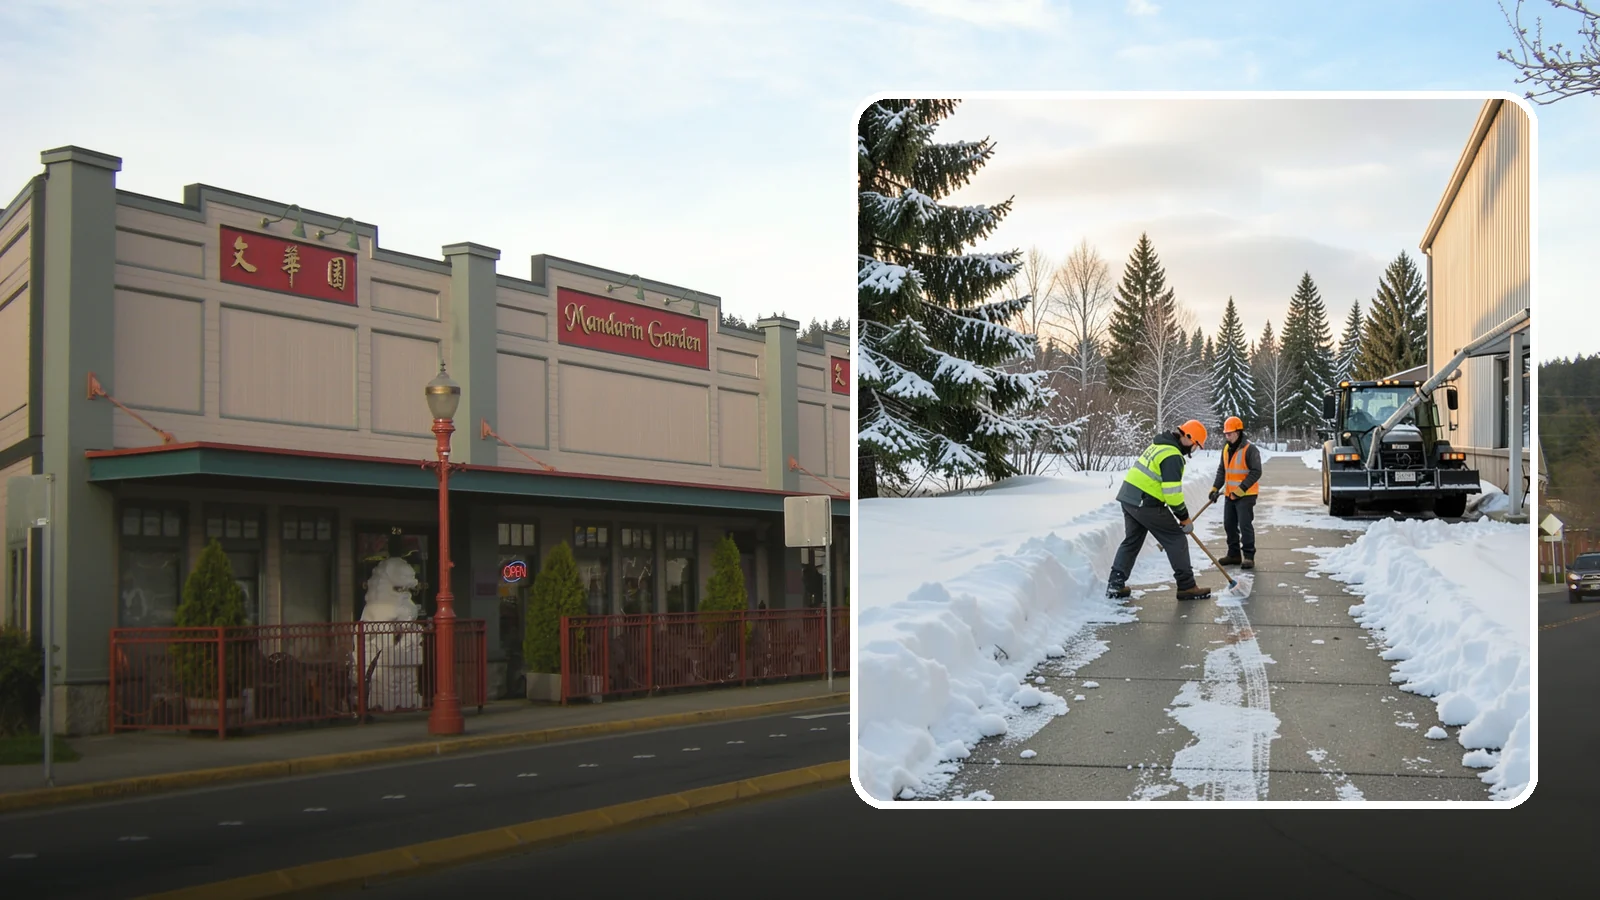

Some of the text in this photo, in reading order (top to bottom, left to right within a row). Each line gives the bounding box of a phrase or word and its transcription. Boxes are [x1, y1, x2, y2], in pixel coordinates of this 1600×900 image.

[231, 236, 346, 291] 文華園
[564, 302, 702, 352] Mandarin Garden
[503, 565, 527, 578] OPEN
